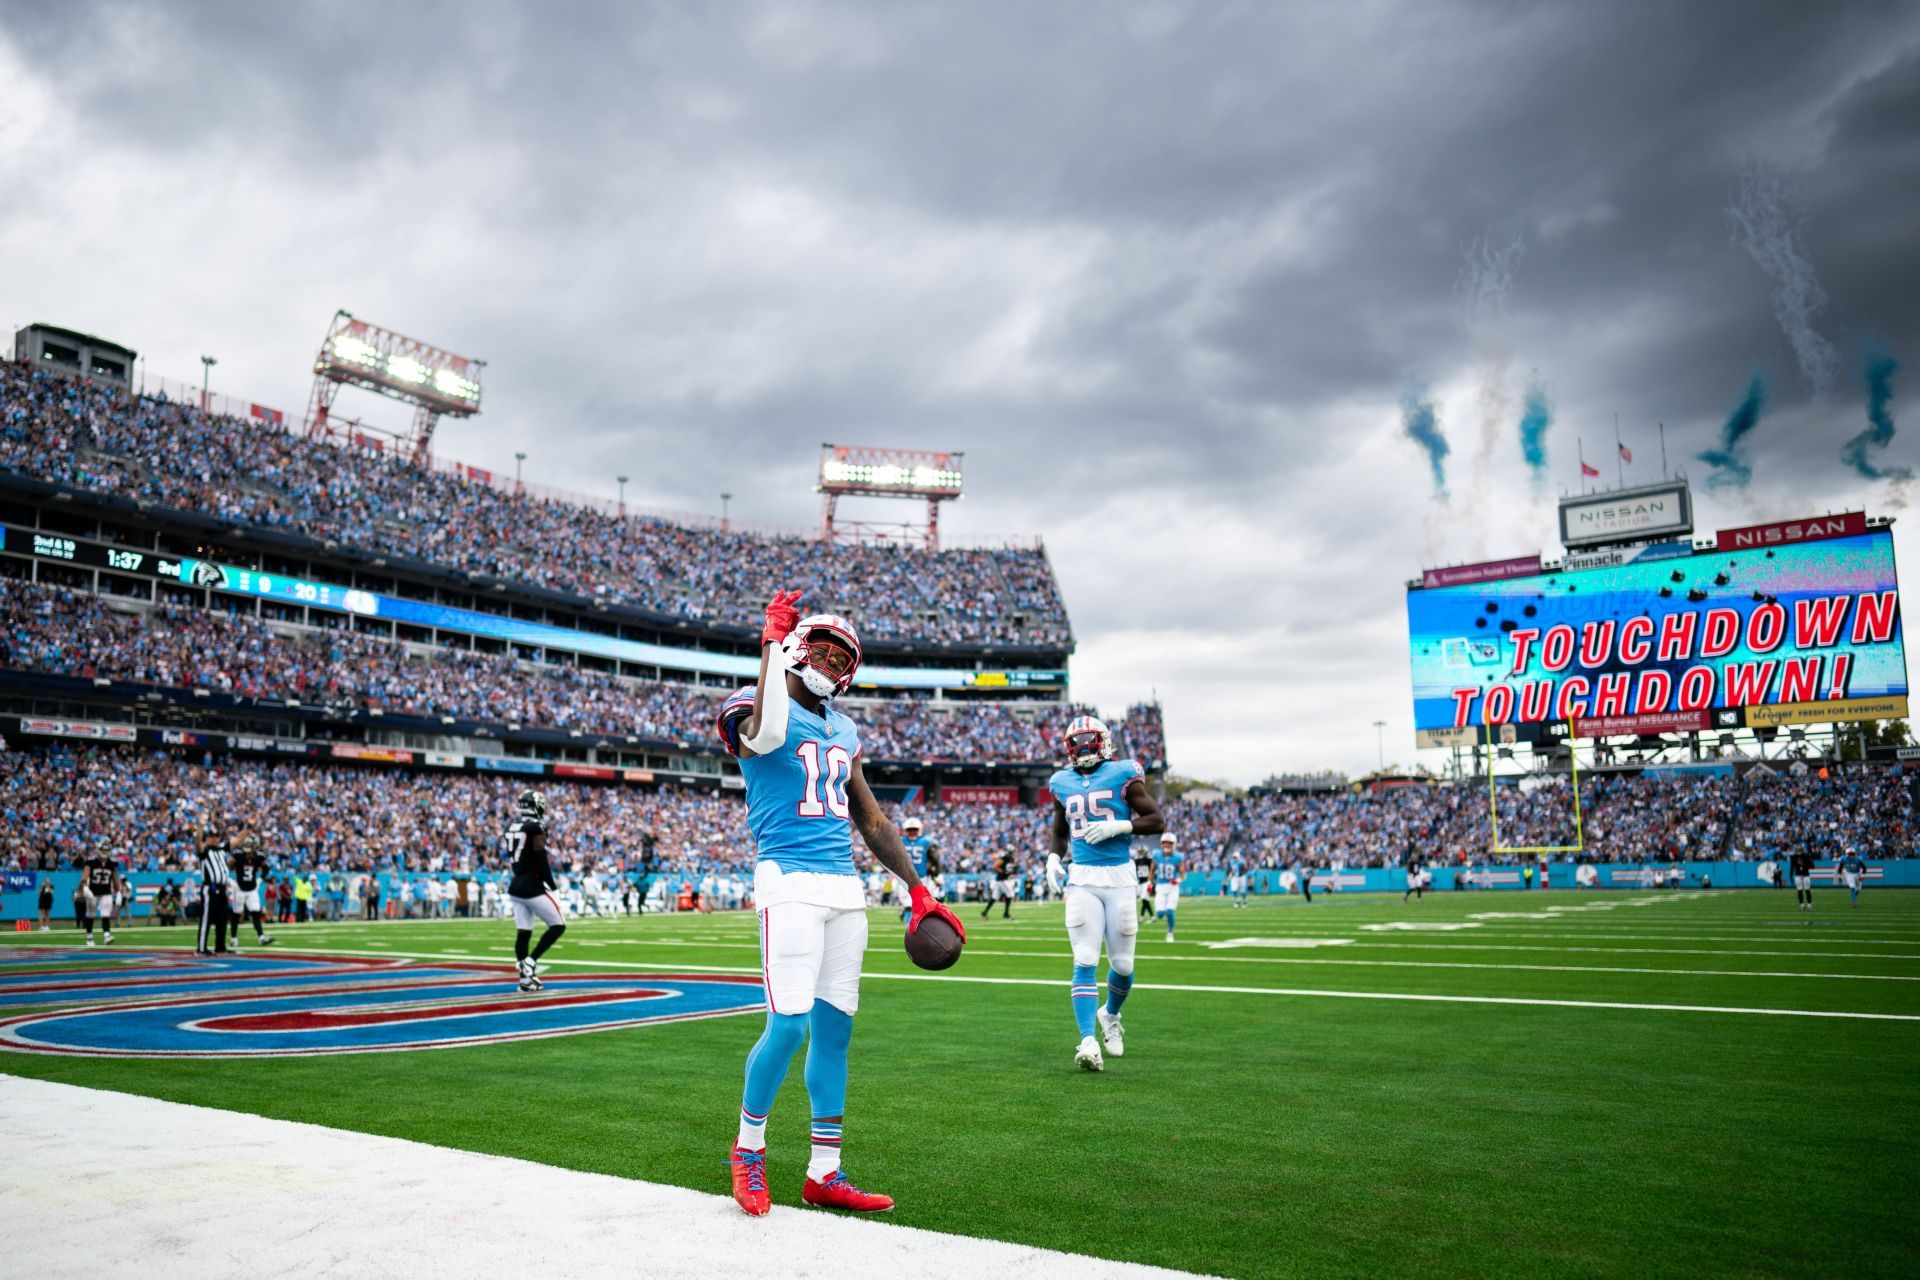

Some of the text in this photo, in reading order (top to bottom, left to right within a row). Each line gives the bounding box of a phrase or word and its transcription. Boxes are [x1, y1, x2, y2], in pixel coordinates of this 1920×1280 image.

[1580, 502, 1664, 522] NISSAN
[1594, 516, 1651, 529] STADIUM
[1735, 519, 1847, 546] NISSAN
[108, 550, 181, 577] 1:37 3rd
[1563, 552, 1623, 569] Pinnacle
[295, 583, 317, 601] 20
[1509, 591, 1897, 675] TOUCHDOWN
[1578, 712, 1701, 730] Farm Bureau INSURANCE
[1754, 705, 1793, 724] Kroger
[1798, 709, 1825, 718] FRESH
[162, 730, 197, 745] FedEx
[1428, 729, 1451, 737] TITAN
[796, 741, 851, 819] 10
[951, 791, 1010, 802] NISSAN
[1066, 790, 1116, 839] 85
[92, 868, 111, 884] 53
[243, 865, 255, 882] 3
[1157, 862, 1175, 880] 18
[10, 876, 32, 886] NFL
